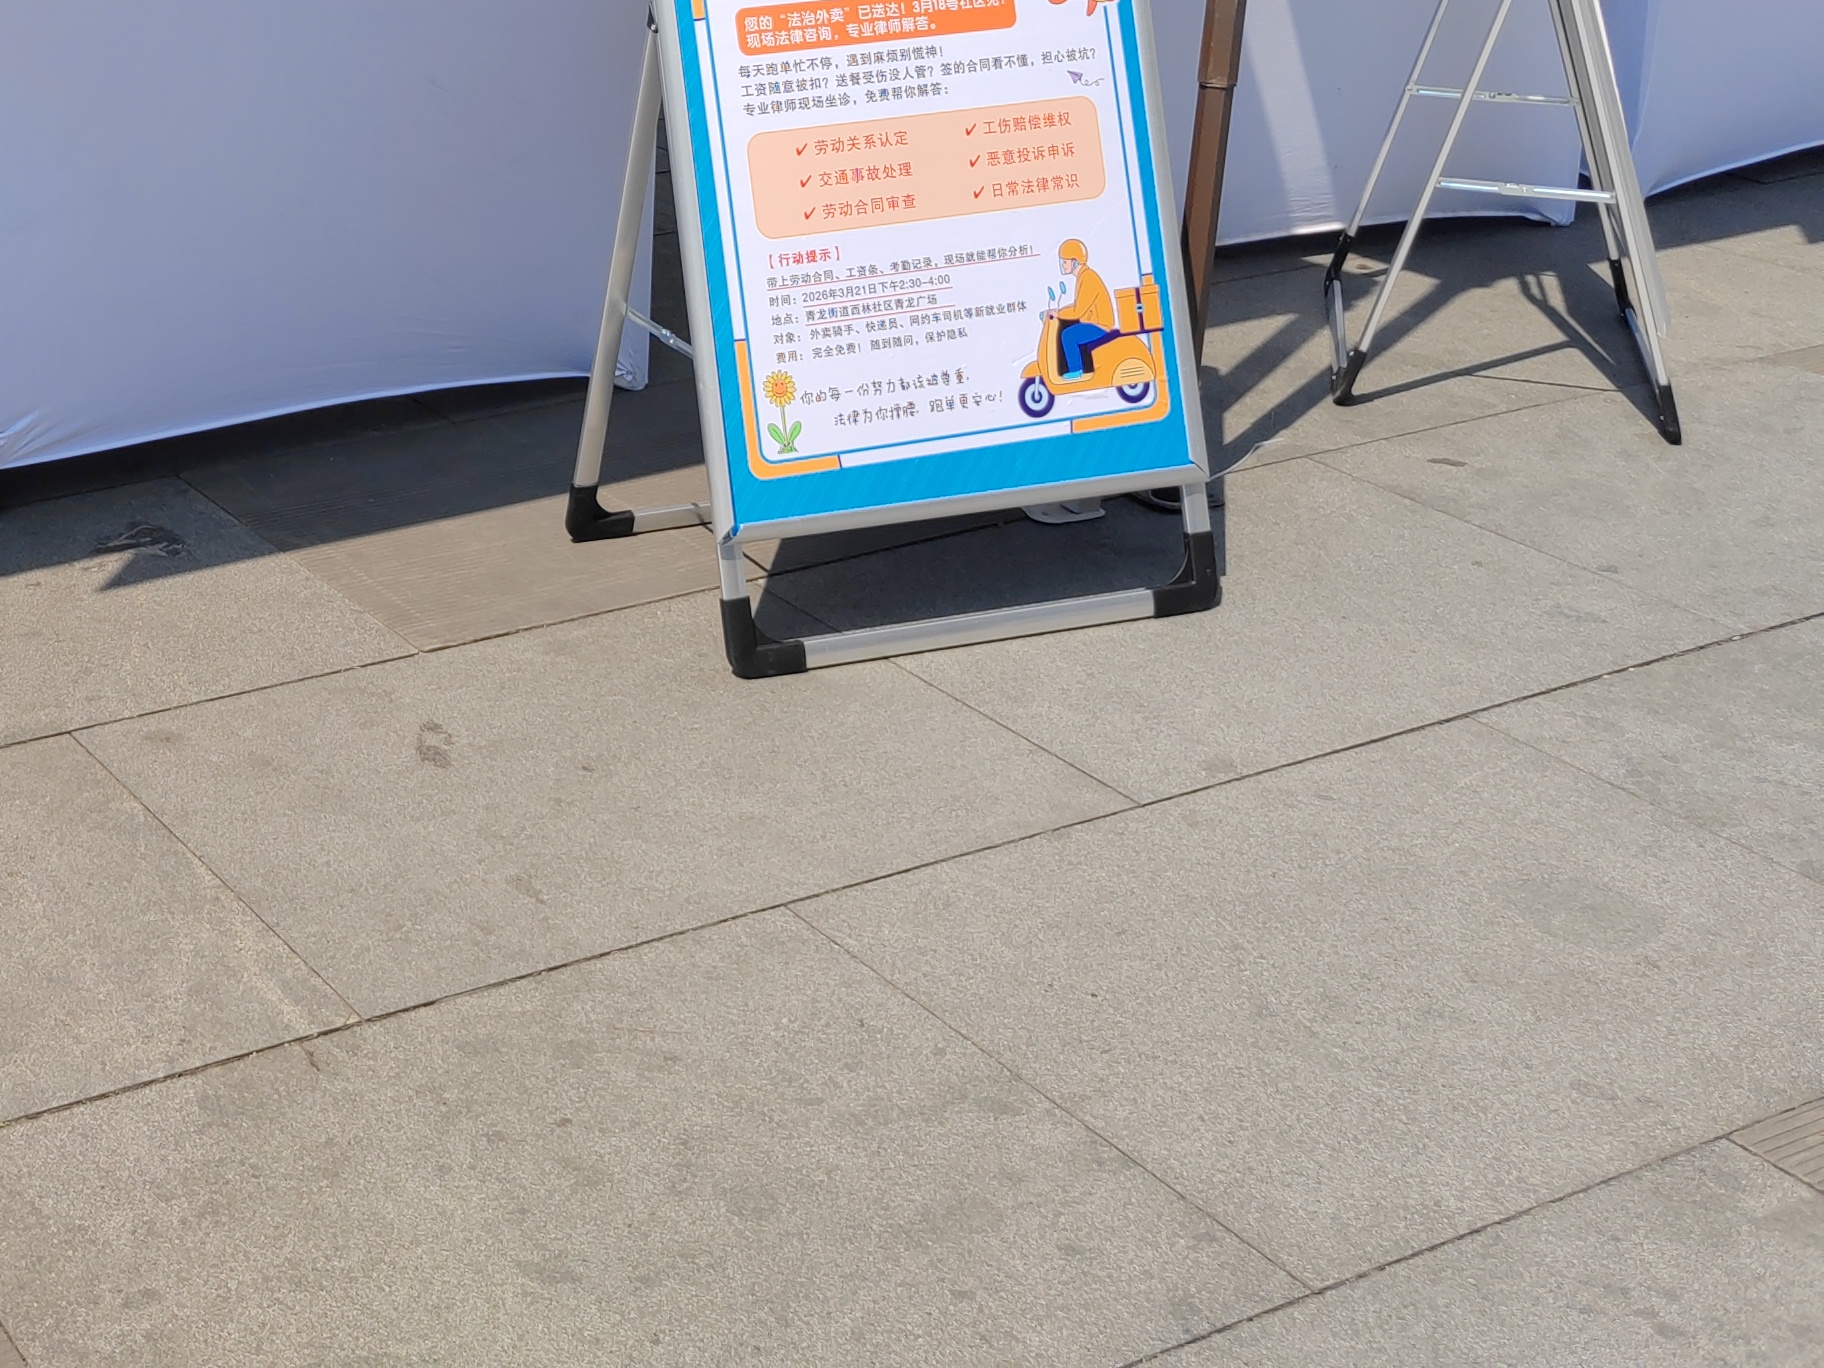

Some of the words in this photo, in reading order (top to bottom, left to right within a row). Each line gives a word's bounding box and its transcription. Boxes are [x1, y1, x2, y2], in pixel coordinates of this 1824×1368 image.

[745, 14, 937, 49] 现场法律咨询，专业律师解答。
[812, 129, 909, 156] 劳动关系认定
[981, 110, 1072, 136] 工伤赔偿维权
[816, 161, 913, 188] 交通事故处理
[985, 141, 1076, 167] 恶意投诉申诉
[820, 192, 917, 220] 劳动合同审查
[990, 173, 1081, 198] 日常法律常识
